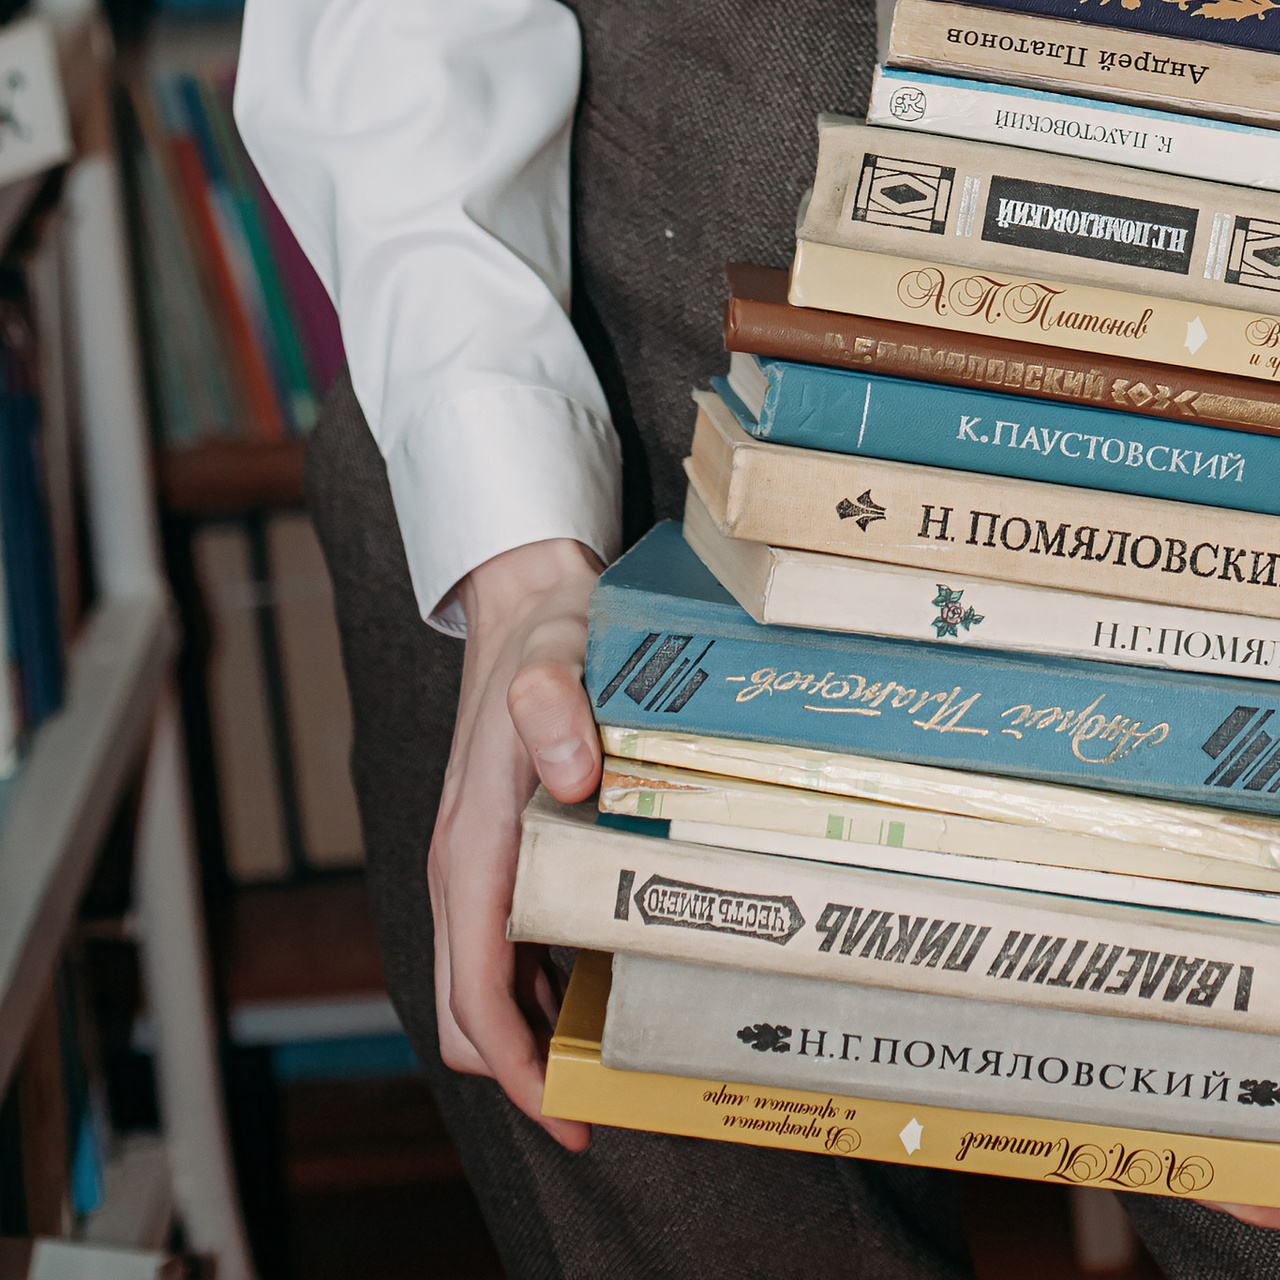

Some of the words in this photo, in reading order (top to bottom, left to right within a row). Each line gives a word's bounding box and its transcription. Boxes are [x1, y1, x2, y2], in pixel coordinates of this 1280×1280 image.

[946, 28, 1088, 68] Платонов
[1098, 49, 1210, 85] Андрей
[994, 108, 1148, 149] ПАУСТОВСКИЙ
[1154, 133, 1173, 153] К.
[1244, 316, 1280, 350] В
[1249, 352, 1261, 366] и
[917, 503, 957, 543] Н.
[734, 666, 990, 737] Платонов
[999, 692, 1171, 766] Андрей
[647, 886, 717, 921] ИМЕЮ
[717, 893, 788, 934] ЧЕСТЬ
[813, 901, 993, 974] ПИКУЛЬ
[986, 928, 1228, 1008] ВАЛЕНТИН
[702, 1088, 751, 1109] мире
[752, 1091, 841, 1122] яростном
[842, 1107, 857, 1121] и
[722, 1112, 823, 1141] прекрасном
[823, 1126, 862, 1157] В
